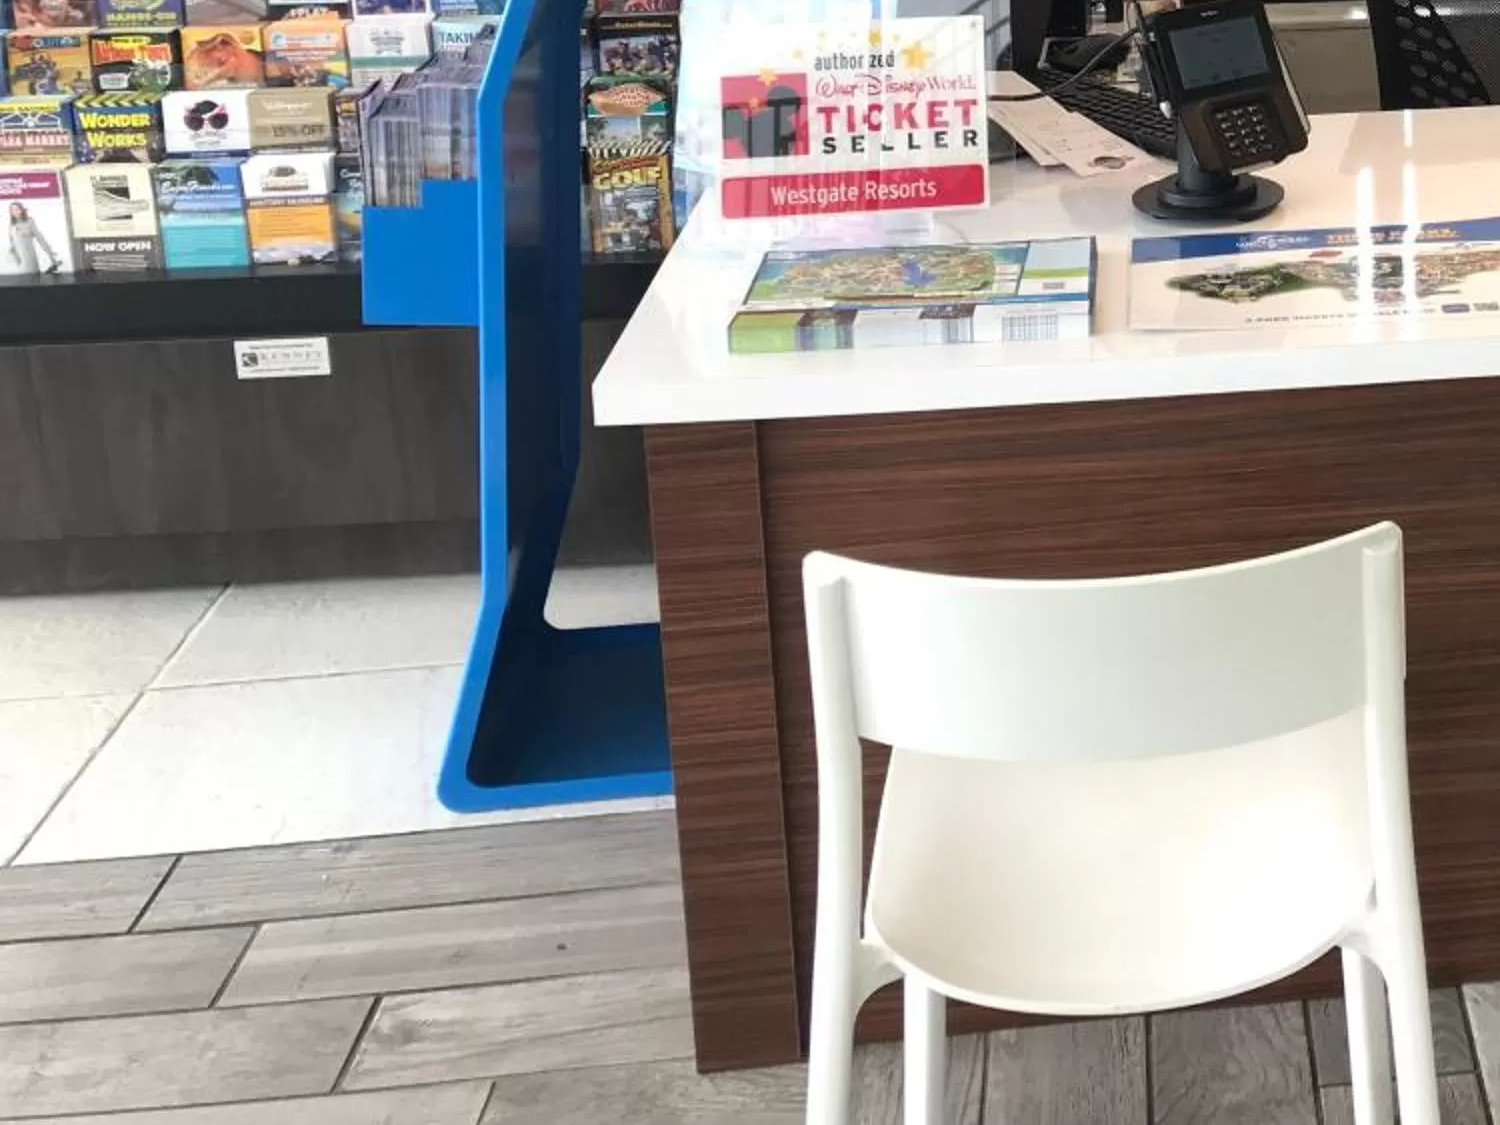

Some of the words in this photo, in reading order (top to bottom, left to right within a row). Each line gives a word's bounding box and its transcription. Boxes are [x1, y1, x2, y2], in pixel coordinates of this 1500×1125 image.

[814, 50, 895, 71] authorzed
[79, 113, 150, 128] WONDER
[816, 99, 979, 134] TICKET
[87, 132, 147, 148] WORKS
[770, 184, 859, 207] Westgate
[863, 178, 937, 201] Resorts
[84, 242, 116, 252] NOW
[118, 241, 151, 252] OPEN
